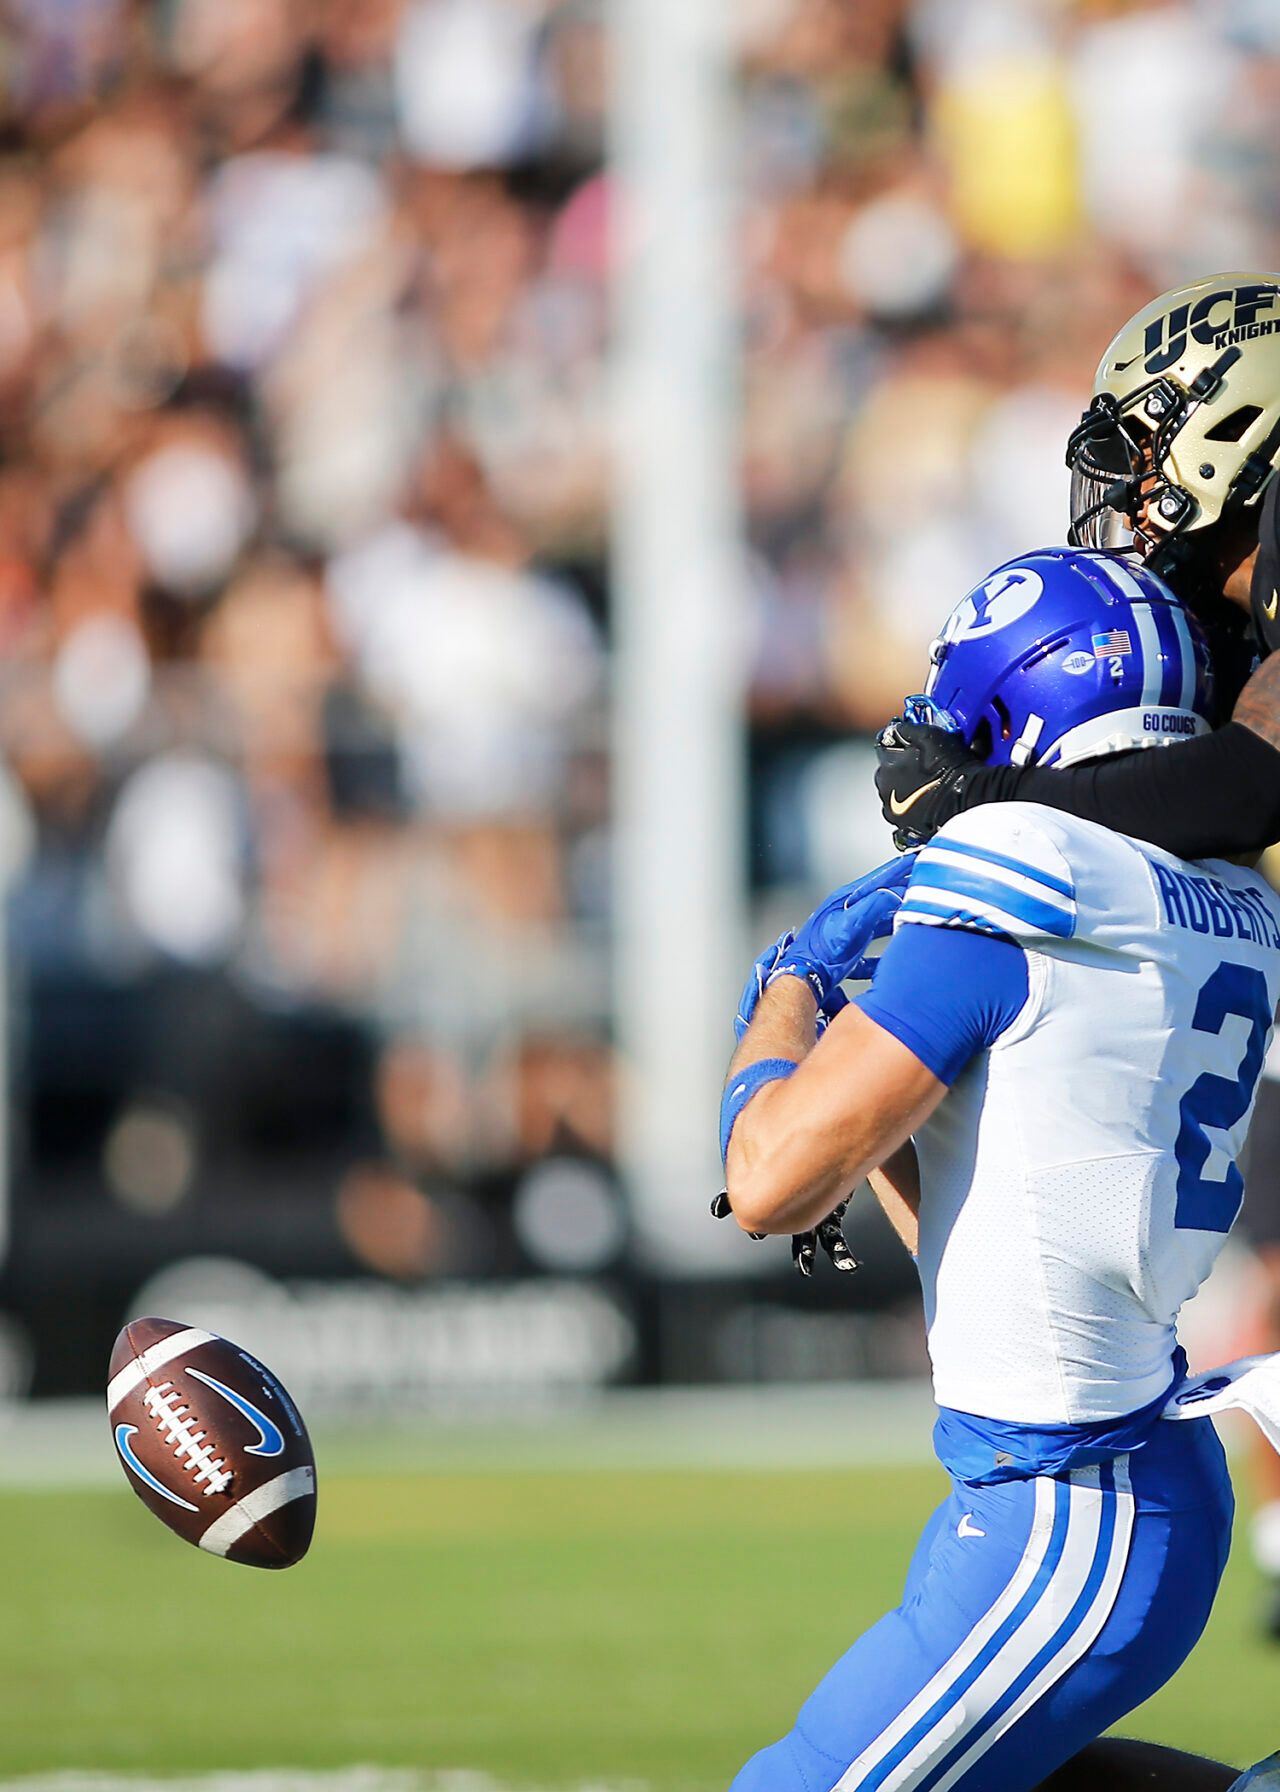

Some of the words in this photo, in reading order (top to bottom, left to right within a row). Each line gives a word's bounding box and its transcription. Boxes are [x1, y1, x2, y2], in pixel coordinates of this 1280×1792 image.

[1144, 285, 1279, 375] UCF
[1108, 656, 1124, 677] 2
[1143, 713, 1160, 731] GO
[1161, 714, 1196, 735] COUGS
[1174, 961, 1273, 1234] 2
